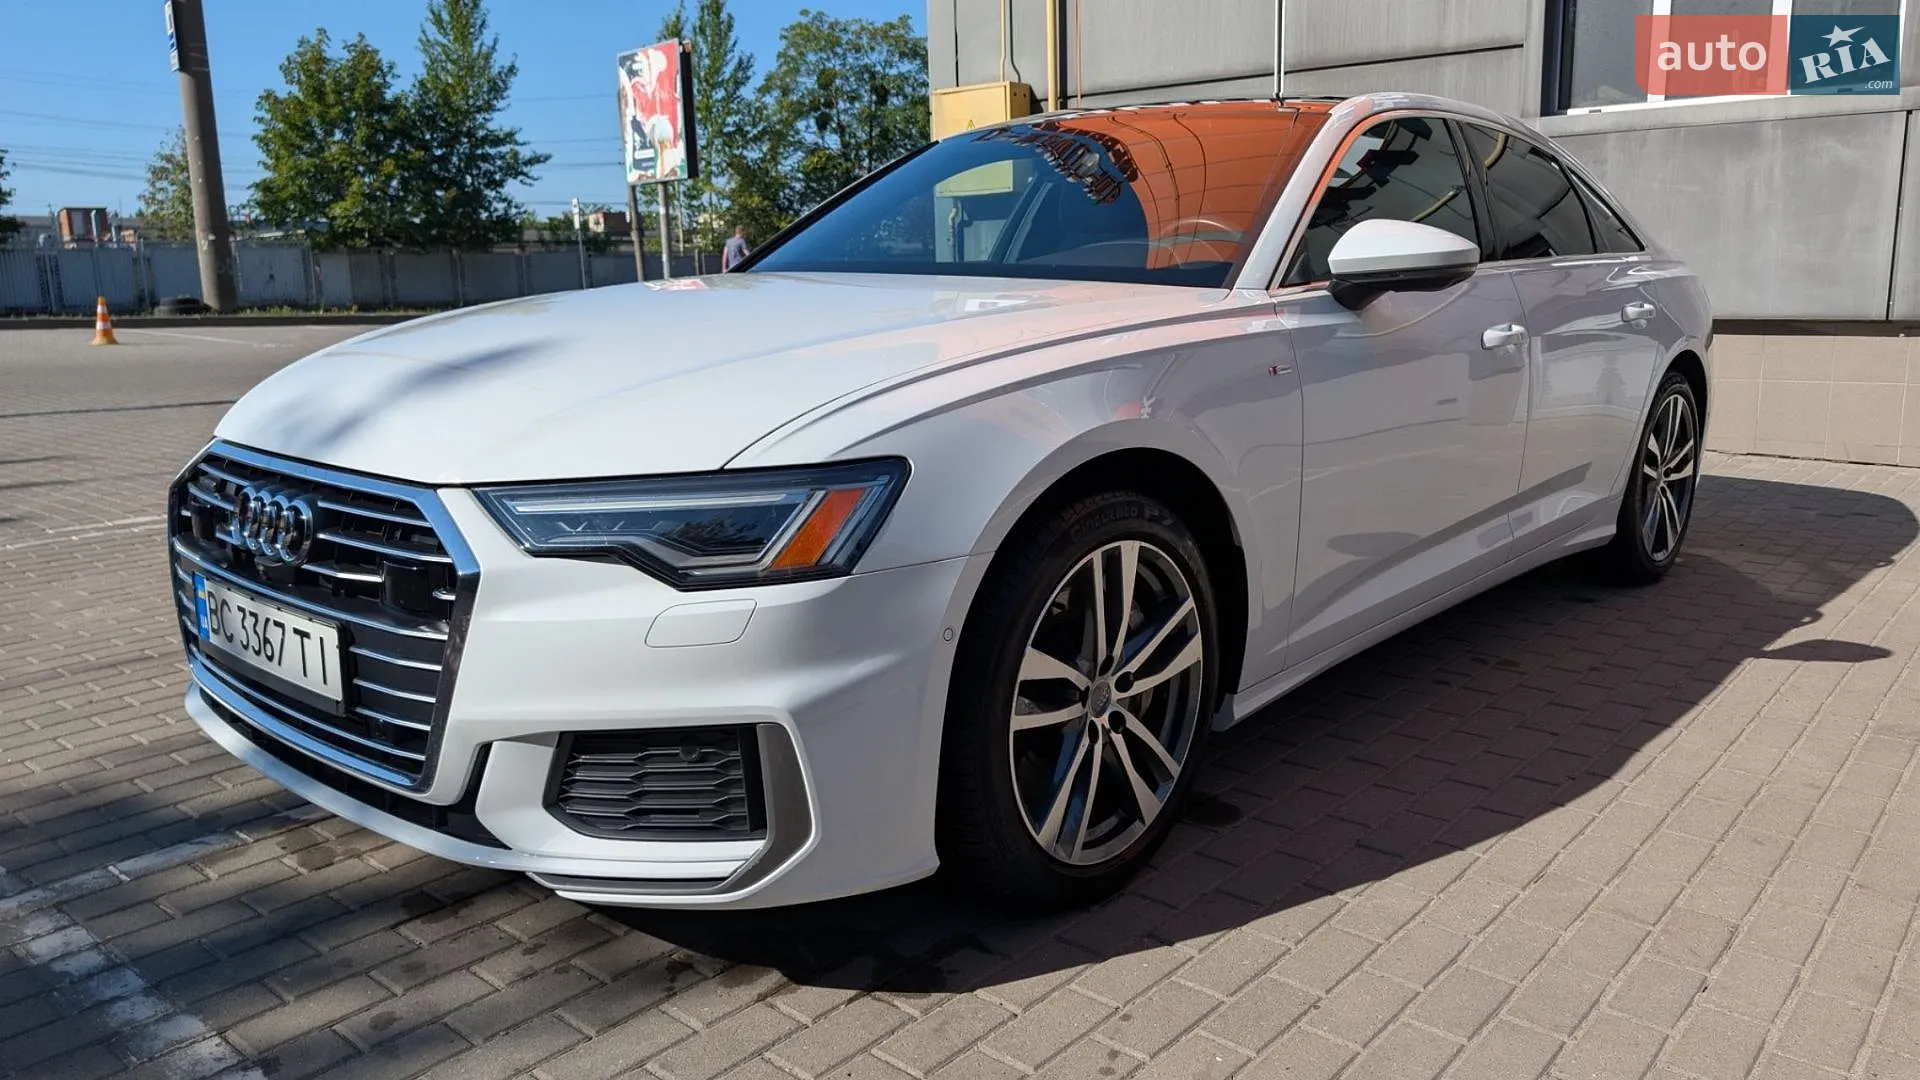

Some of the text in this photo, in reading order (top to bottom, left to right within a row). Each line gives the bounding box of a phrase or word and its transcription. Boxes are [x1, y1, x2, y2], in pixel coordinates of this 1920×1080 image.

[208, 591, 328, 686] BC 3367 TI
